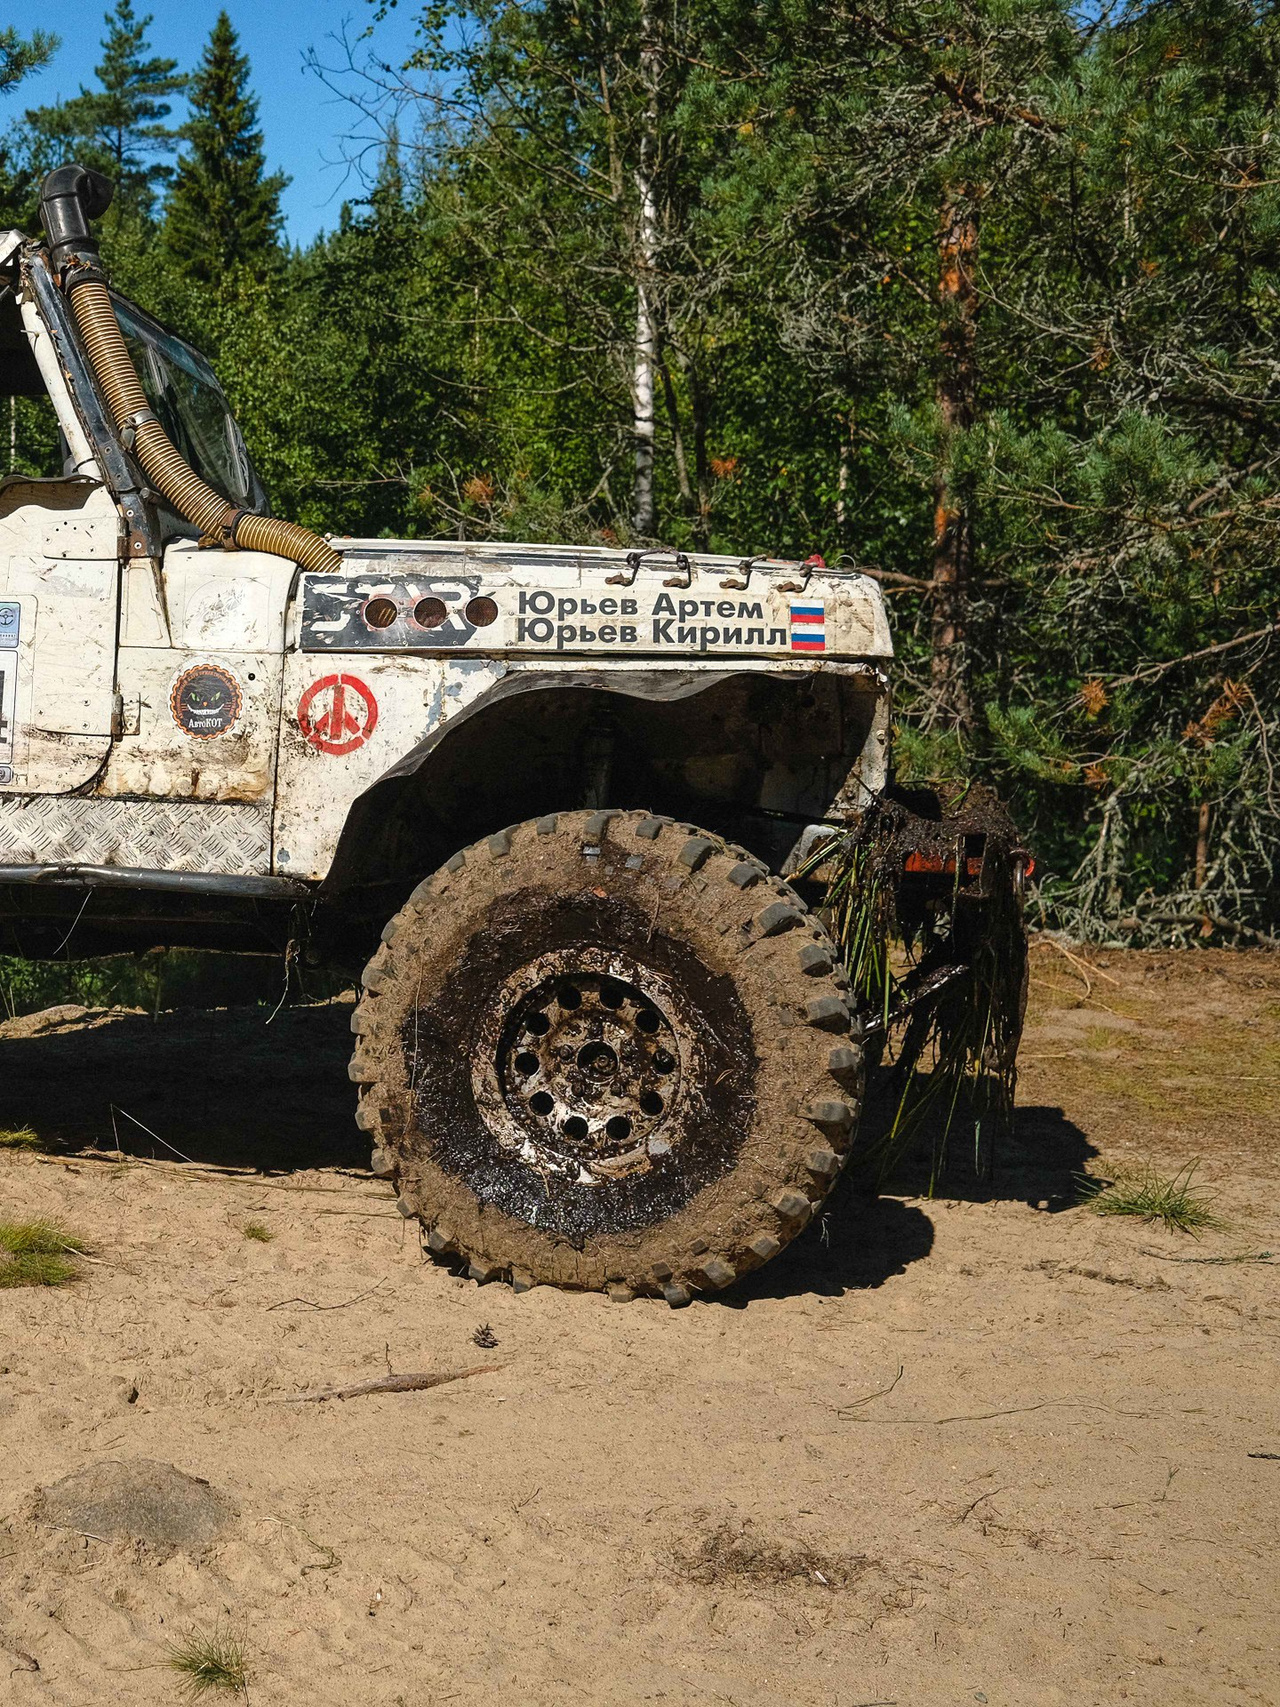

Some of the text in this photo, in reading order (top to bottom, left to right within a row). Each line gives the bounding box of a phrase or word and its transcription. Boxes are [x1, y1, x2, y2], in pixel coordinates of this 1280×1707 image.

[518, 591, 763, 623] Юрьев Артем
[517, 617, 787, 651] Юрьев Кирилл
